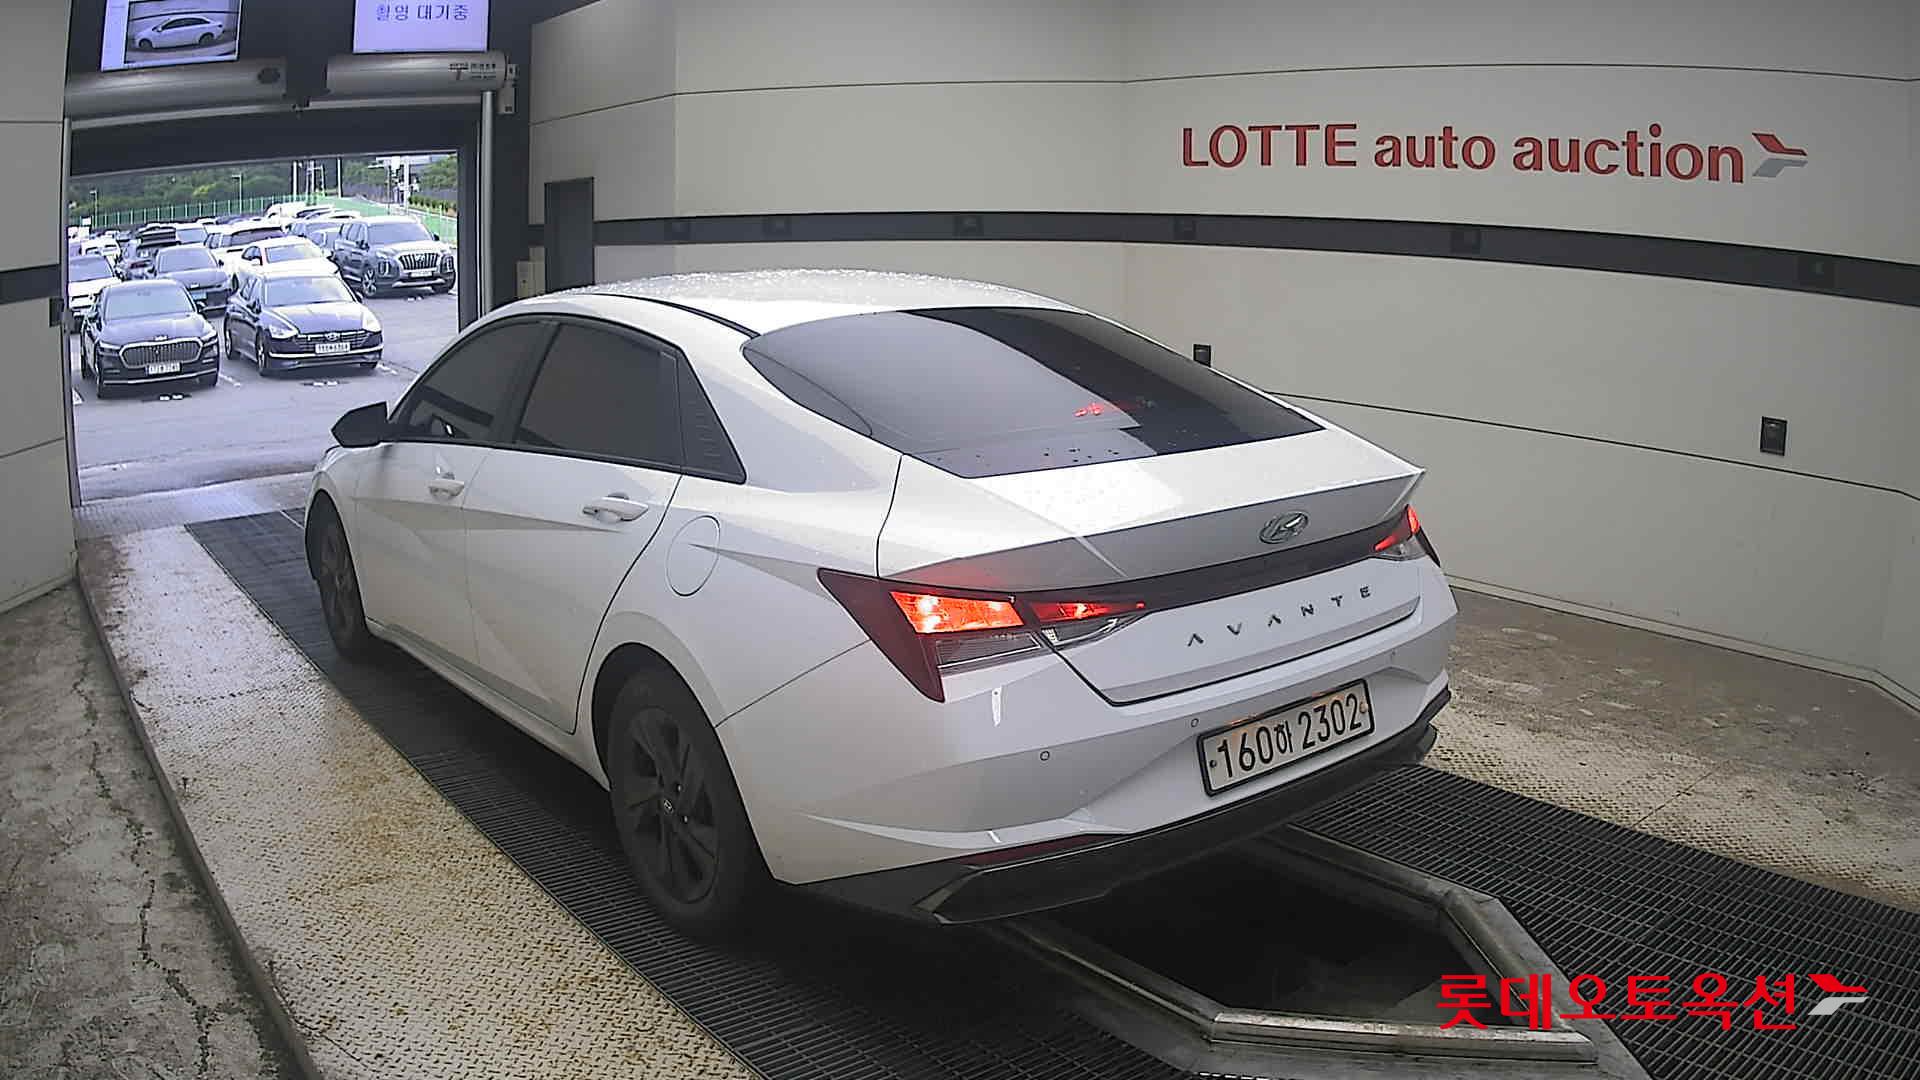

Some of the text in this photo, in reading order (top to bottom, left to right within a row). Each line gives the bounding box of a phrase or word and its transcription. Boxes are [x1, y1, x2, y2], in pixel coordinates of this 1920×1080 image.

[416, 3, 469, 21] 대기중
[1182, 122, 1745, 184] LOTTE auto auction
[1186, 585, 1373, 648] AVANTE
[1217, 692, 1363, 779] 160하 2302
